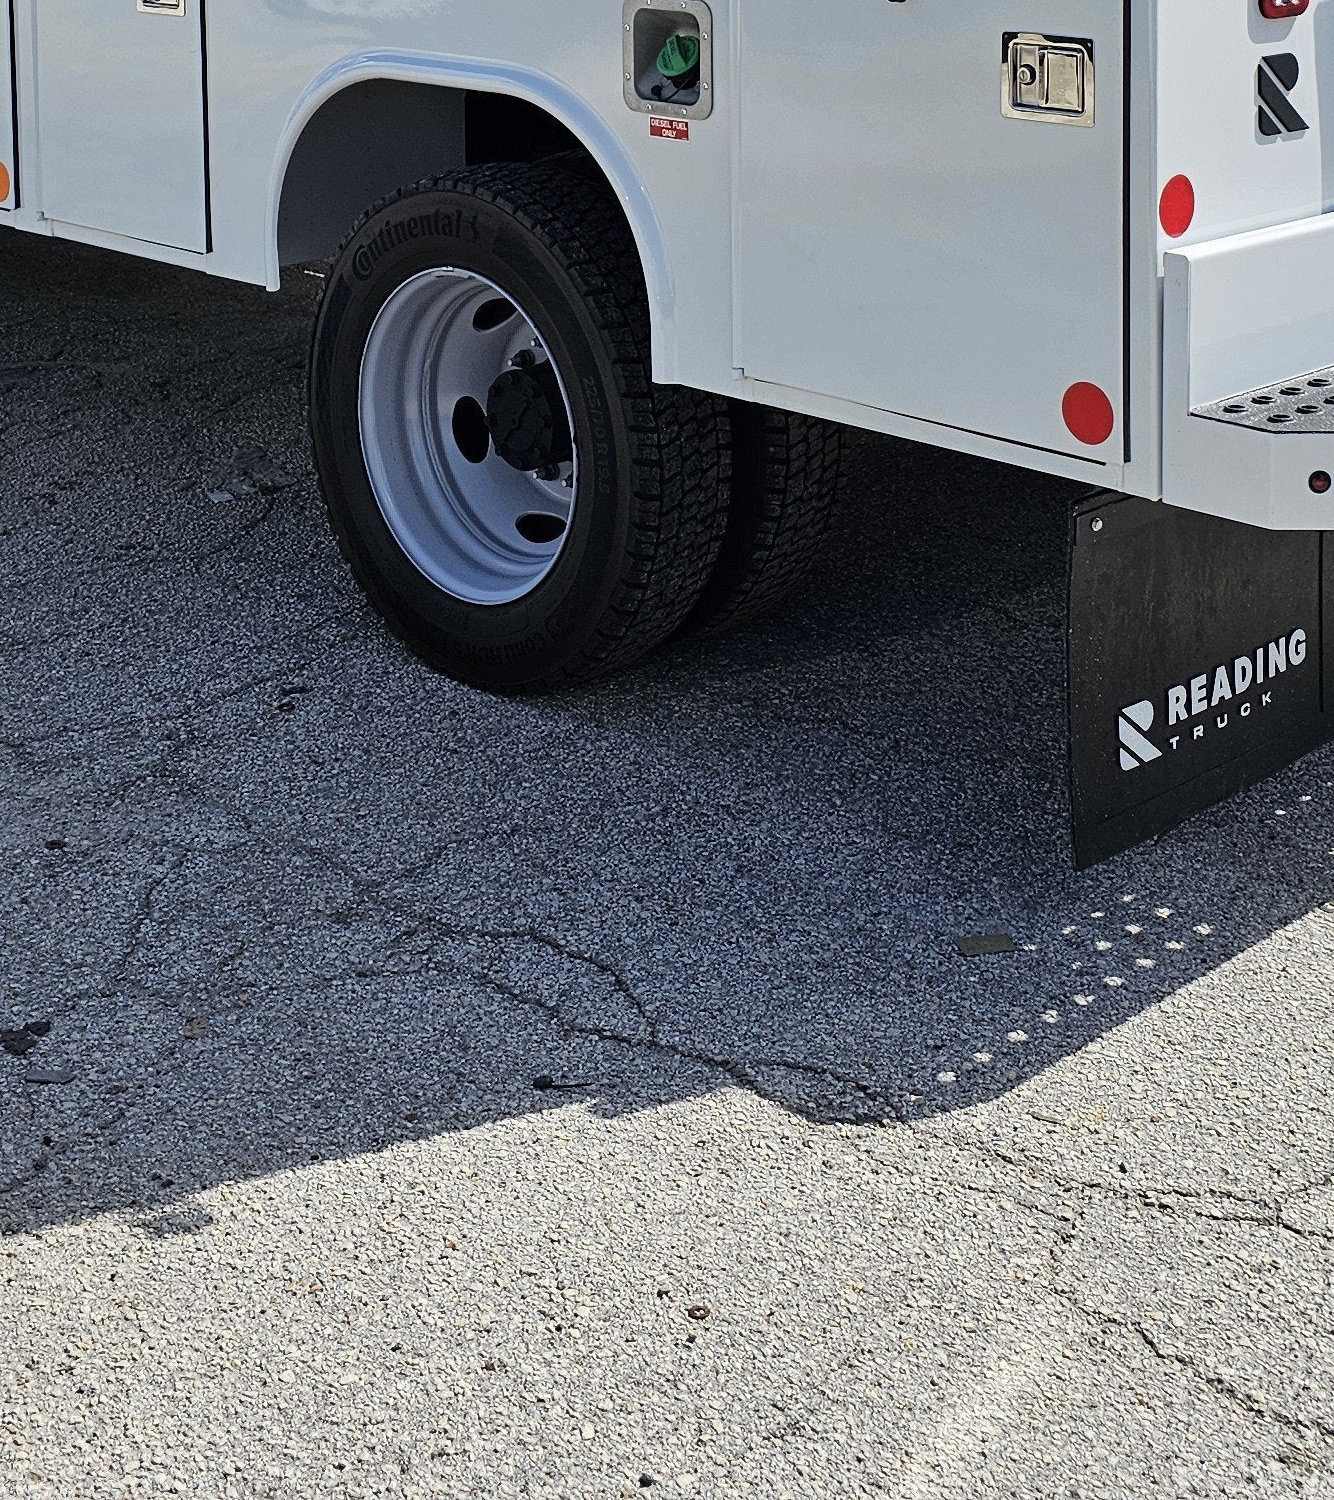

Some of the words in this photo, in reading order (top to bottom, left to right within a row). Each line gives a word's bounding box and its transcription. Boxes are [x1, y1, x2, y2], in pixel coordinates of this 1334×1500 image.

[651, 119, 671, 129] DIESEL
[672, 121, 687, 131] FUEL
[661, 129, 677, 138] ONLY
[352, 208, 464, 281] Continental
[1167, 628, 1307, 726] READING
[1169, 691, 1272, 750] TRUCK
